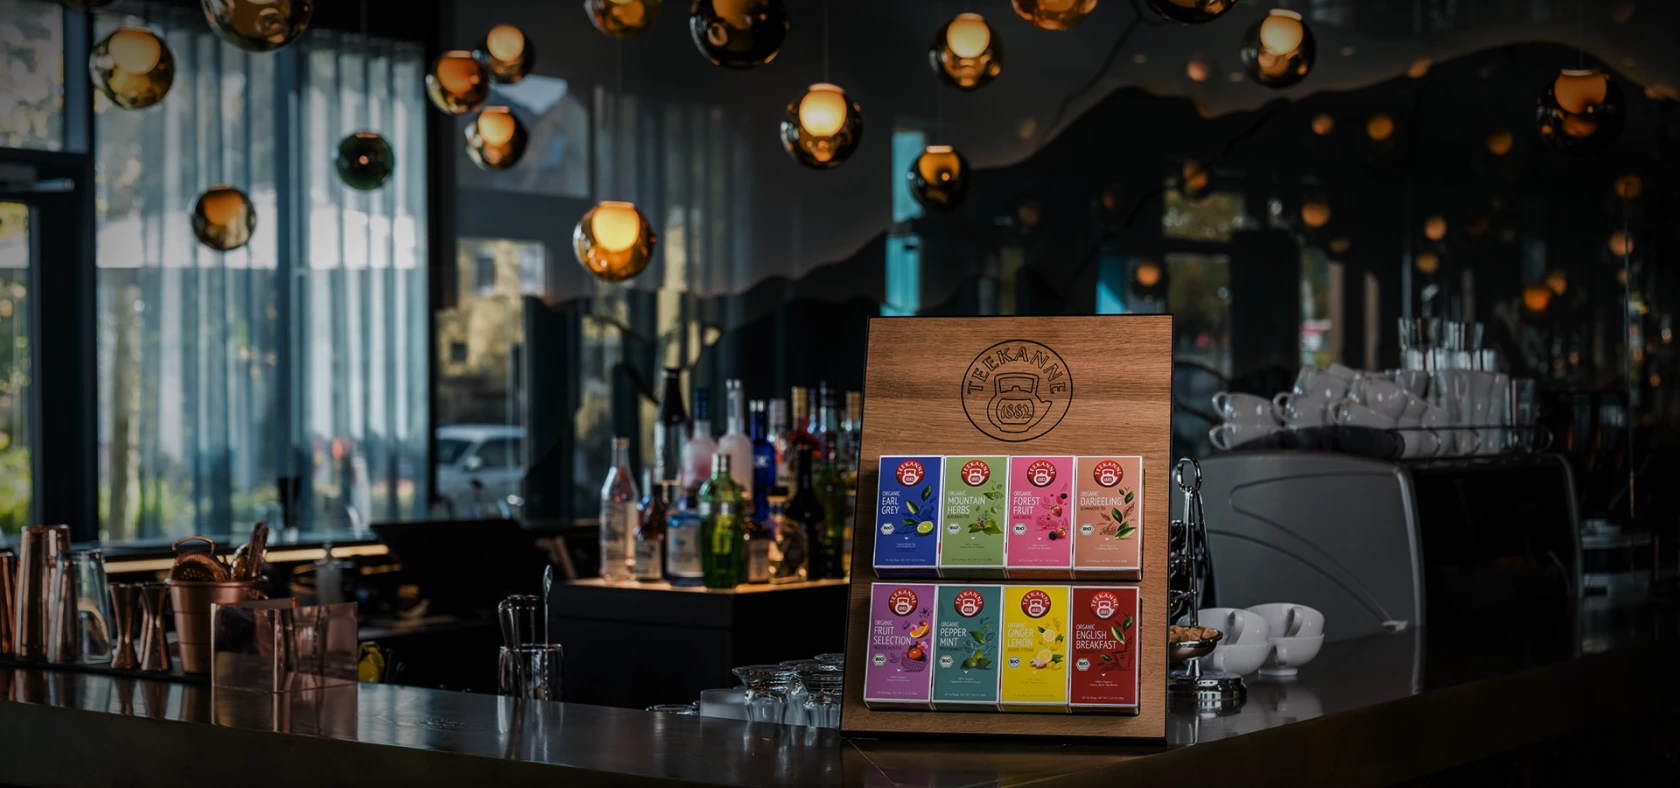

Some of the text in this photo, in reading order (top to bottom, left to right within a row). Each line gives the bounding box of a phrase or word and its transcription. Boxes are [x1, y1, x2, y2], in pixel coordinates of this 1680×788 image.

[967, 346, 1067, 395] TEEKANNE
[1000, 403, 1032, 420] 1882
[896, 461, 924, 475] TEEKANNE
[962, 461, 989, 475] TEEKANNE
[1028, 461, 1055, 475] TEEKANNE
[1095, 461, 1122, 475] TEEKANNE
[881, 497, 899, 505] EARL
[947, 496, 986, 505] MOUNTAIN
[1013, 497, 1040, 505] FOREST
[1080, 497, 1122, 506] DARJEELING
[881, 506, 900, 514] GREY
[947, 506, 970, 514] HERBS
[1013, 506, 1033, 514] FRUIT
[889, 590, 917, 604] TEEKANNE
[955, 591, 983, 605] TEEKANNE
[1022, 592, 1050, 605] TEEKANNE
[1091, 593, 1119, 607] TEEKANNE
[874, 626, 894, 635] FRUIT
[940, 628, 966, 637] PEPPER
[1007, 629, 1034, 637] GINGER
[1076, 631, 1107, 639] ENGLISH
[873, 636, 912, 645] SELECTION
[940, 638, 958, 646] MINT
[1007, 638, 1033, 647] LEMON
[1076, 641, 1117, 649] BREAKFAST
